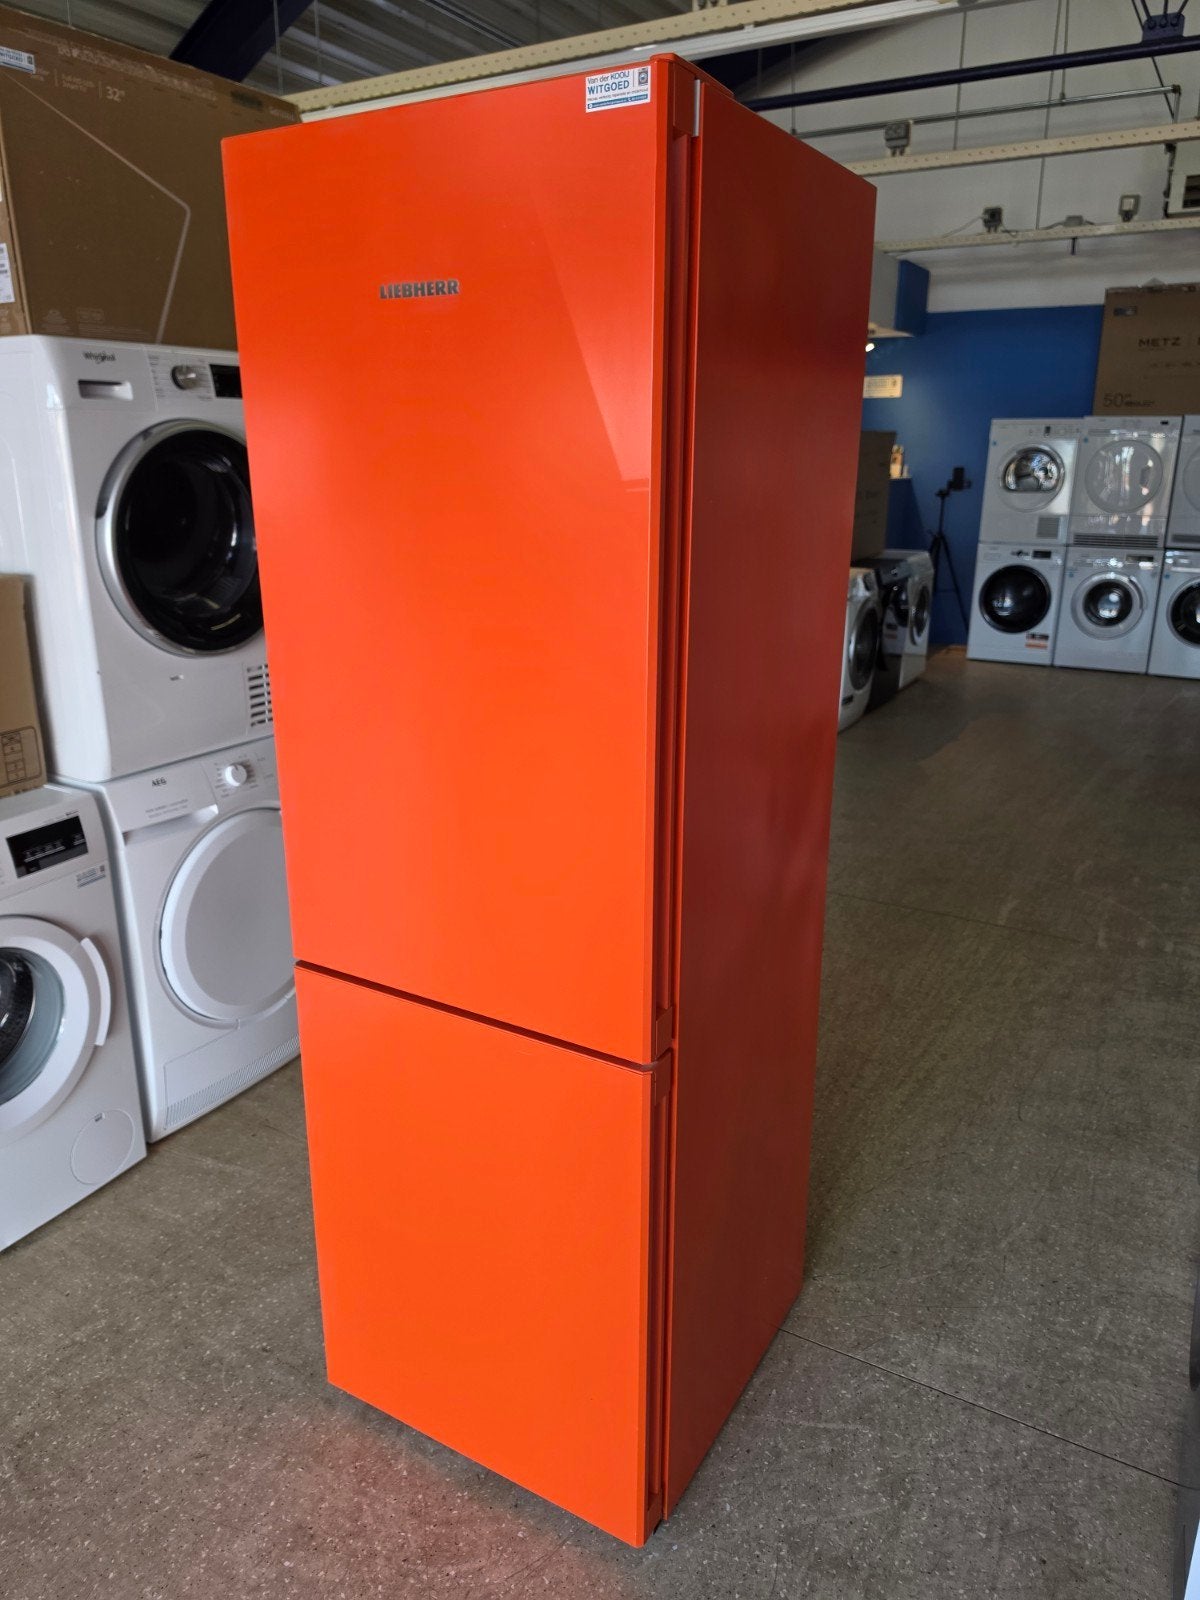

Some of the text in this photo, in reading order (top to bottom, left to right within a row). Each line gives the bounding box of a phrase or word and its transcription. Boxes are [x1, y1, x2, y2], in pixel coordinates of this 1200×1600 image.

[588, 77, 599, 85] Van
[600, 75, 609, 83] der
[588, 80, 630, 96] WITGOED
[379, 279, 459, 299] LIEBHERR
[1138, 336, 1182, 348] METZ
[152, 777, 167, 786] AEG
